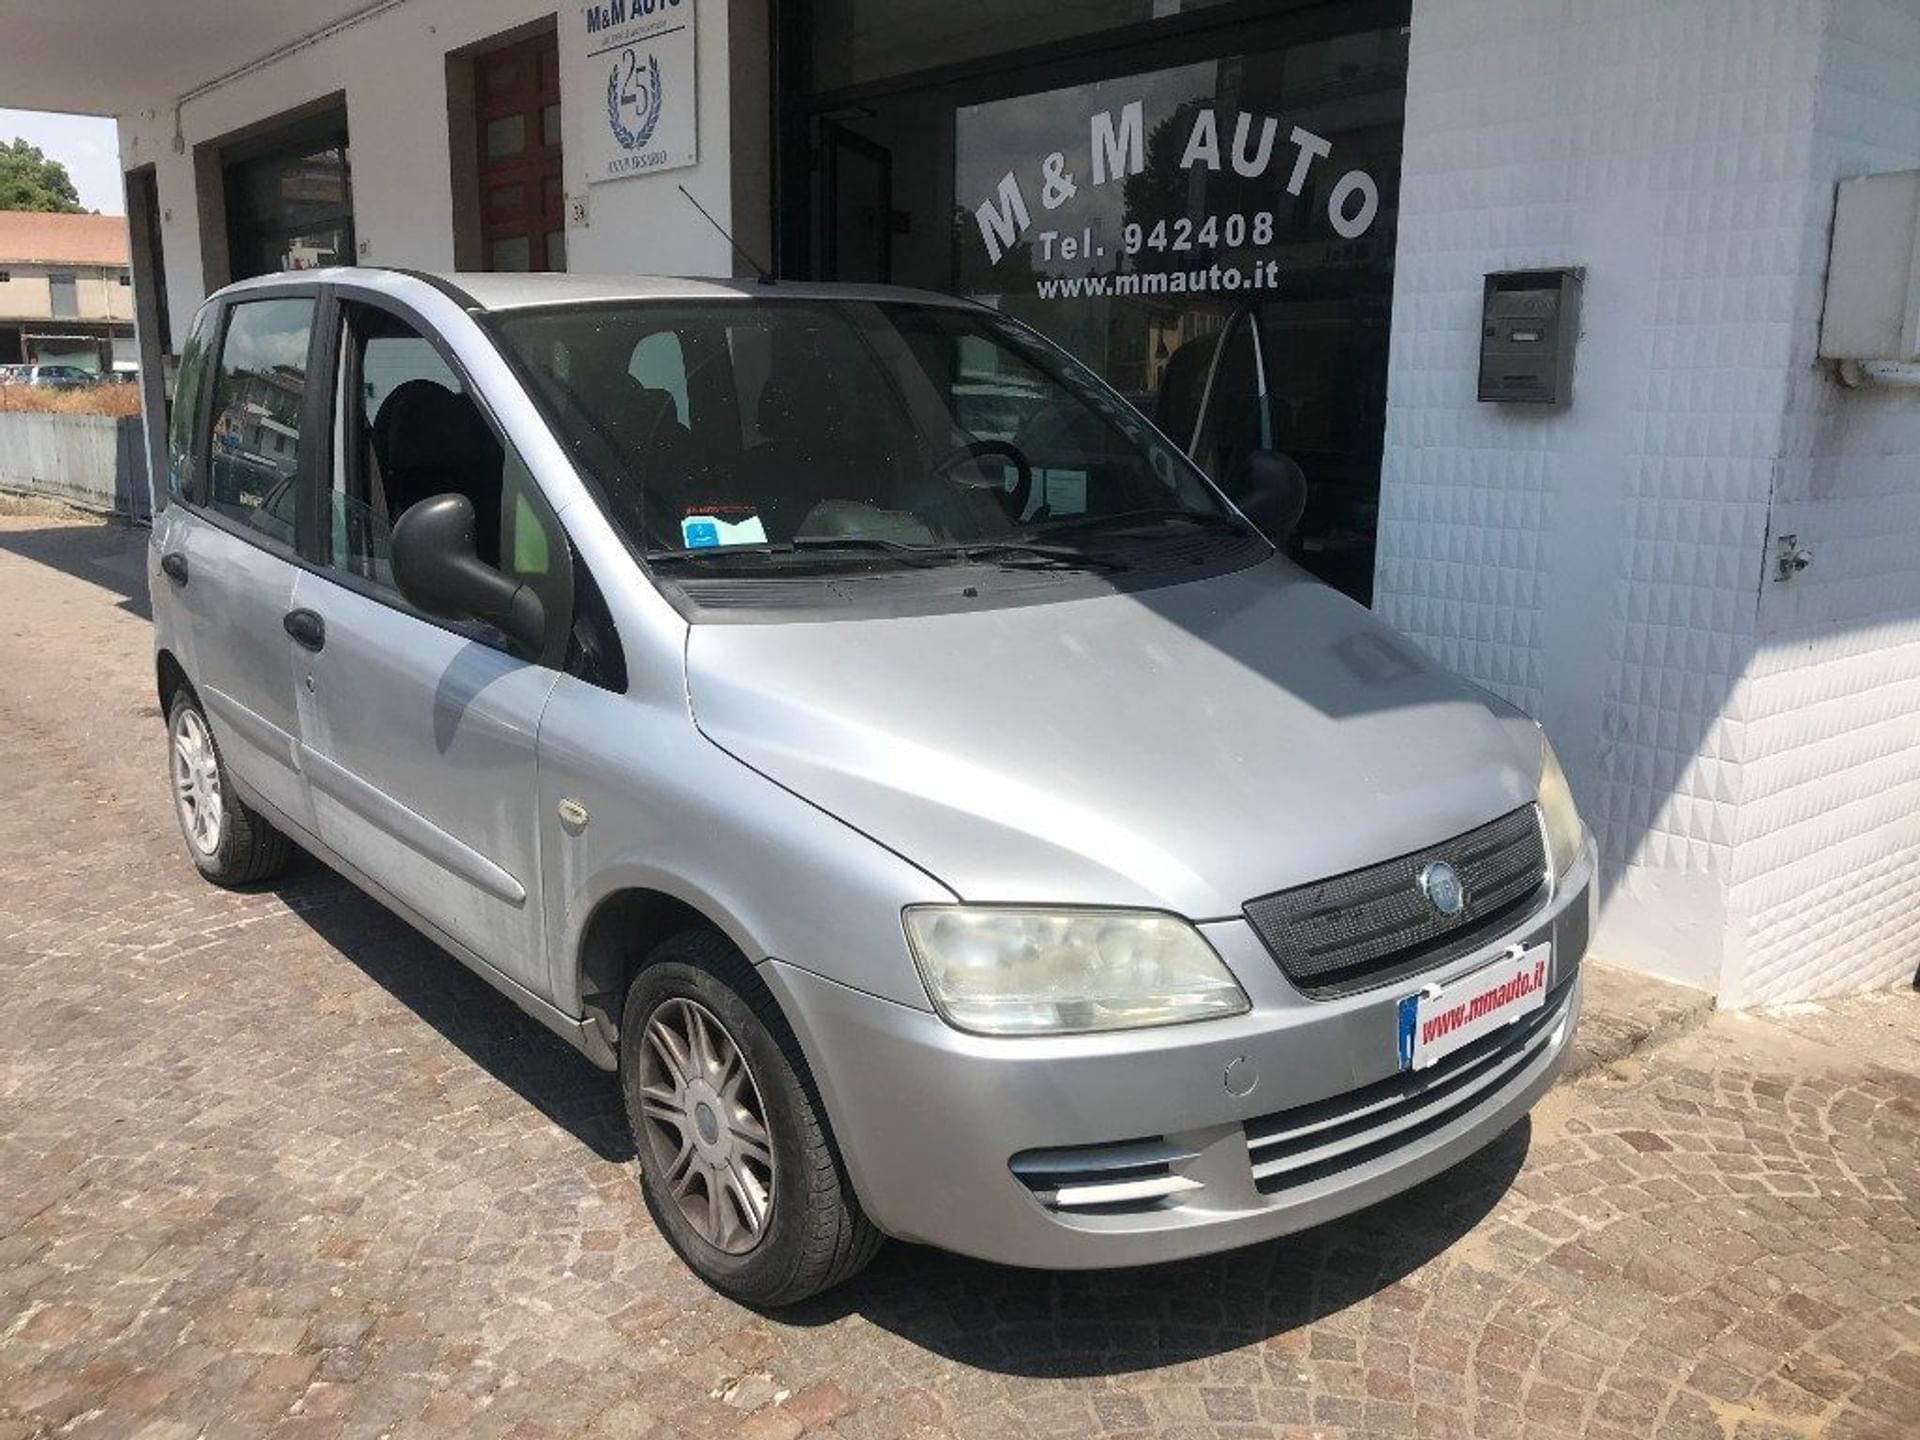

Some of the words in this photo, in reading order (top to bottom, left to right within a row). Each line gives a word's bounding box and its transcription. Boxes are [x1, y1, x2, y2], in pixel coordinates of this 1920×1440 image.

[587, 0, 626, 33] M&M
[620, 48, 649, 117] 25
[974, 171, 1032, 266] M
[1041, 151, 1078, 211] &
[1090, 100, 1145, 186] M
[1179, 108, 1380, 240] AUTO
[1039, 226, 1105, 261] Tel.
[1124, 211, 1274, 255] 942408
[1036, 259, 1279, 300] www.mmauto.it
[1422, 960, 1545, 1046] www.mmauto.it
